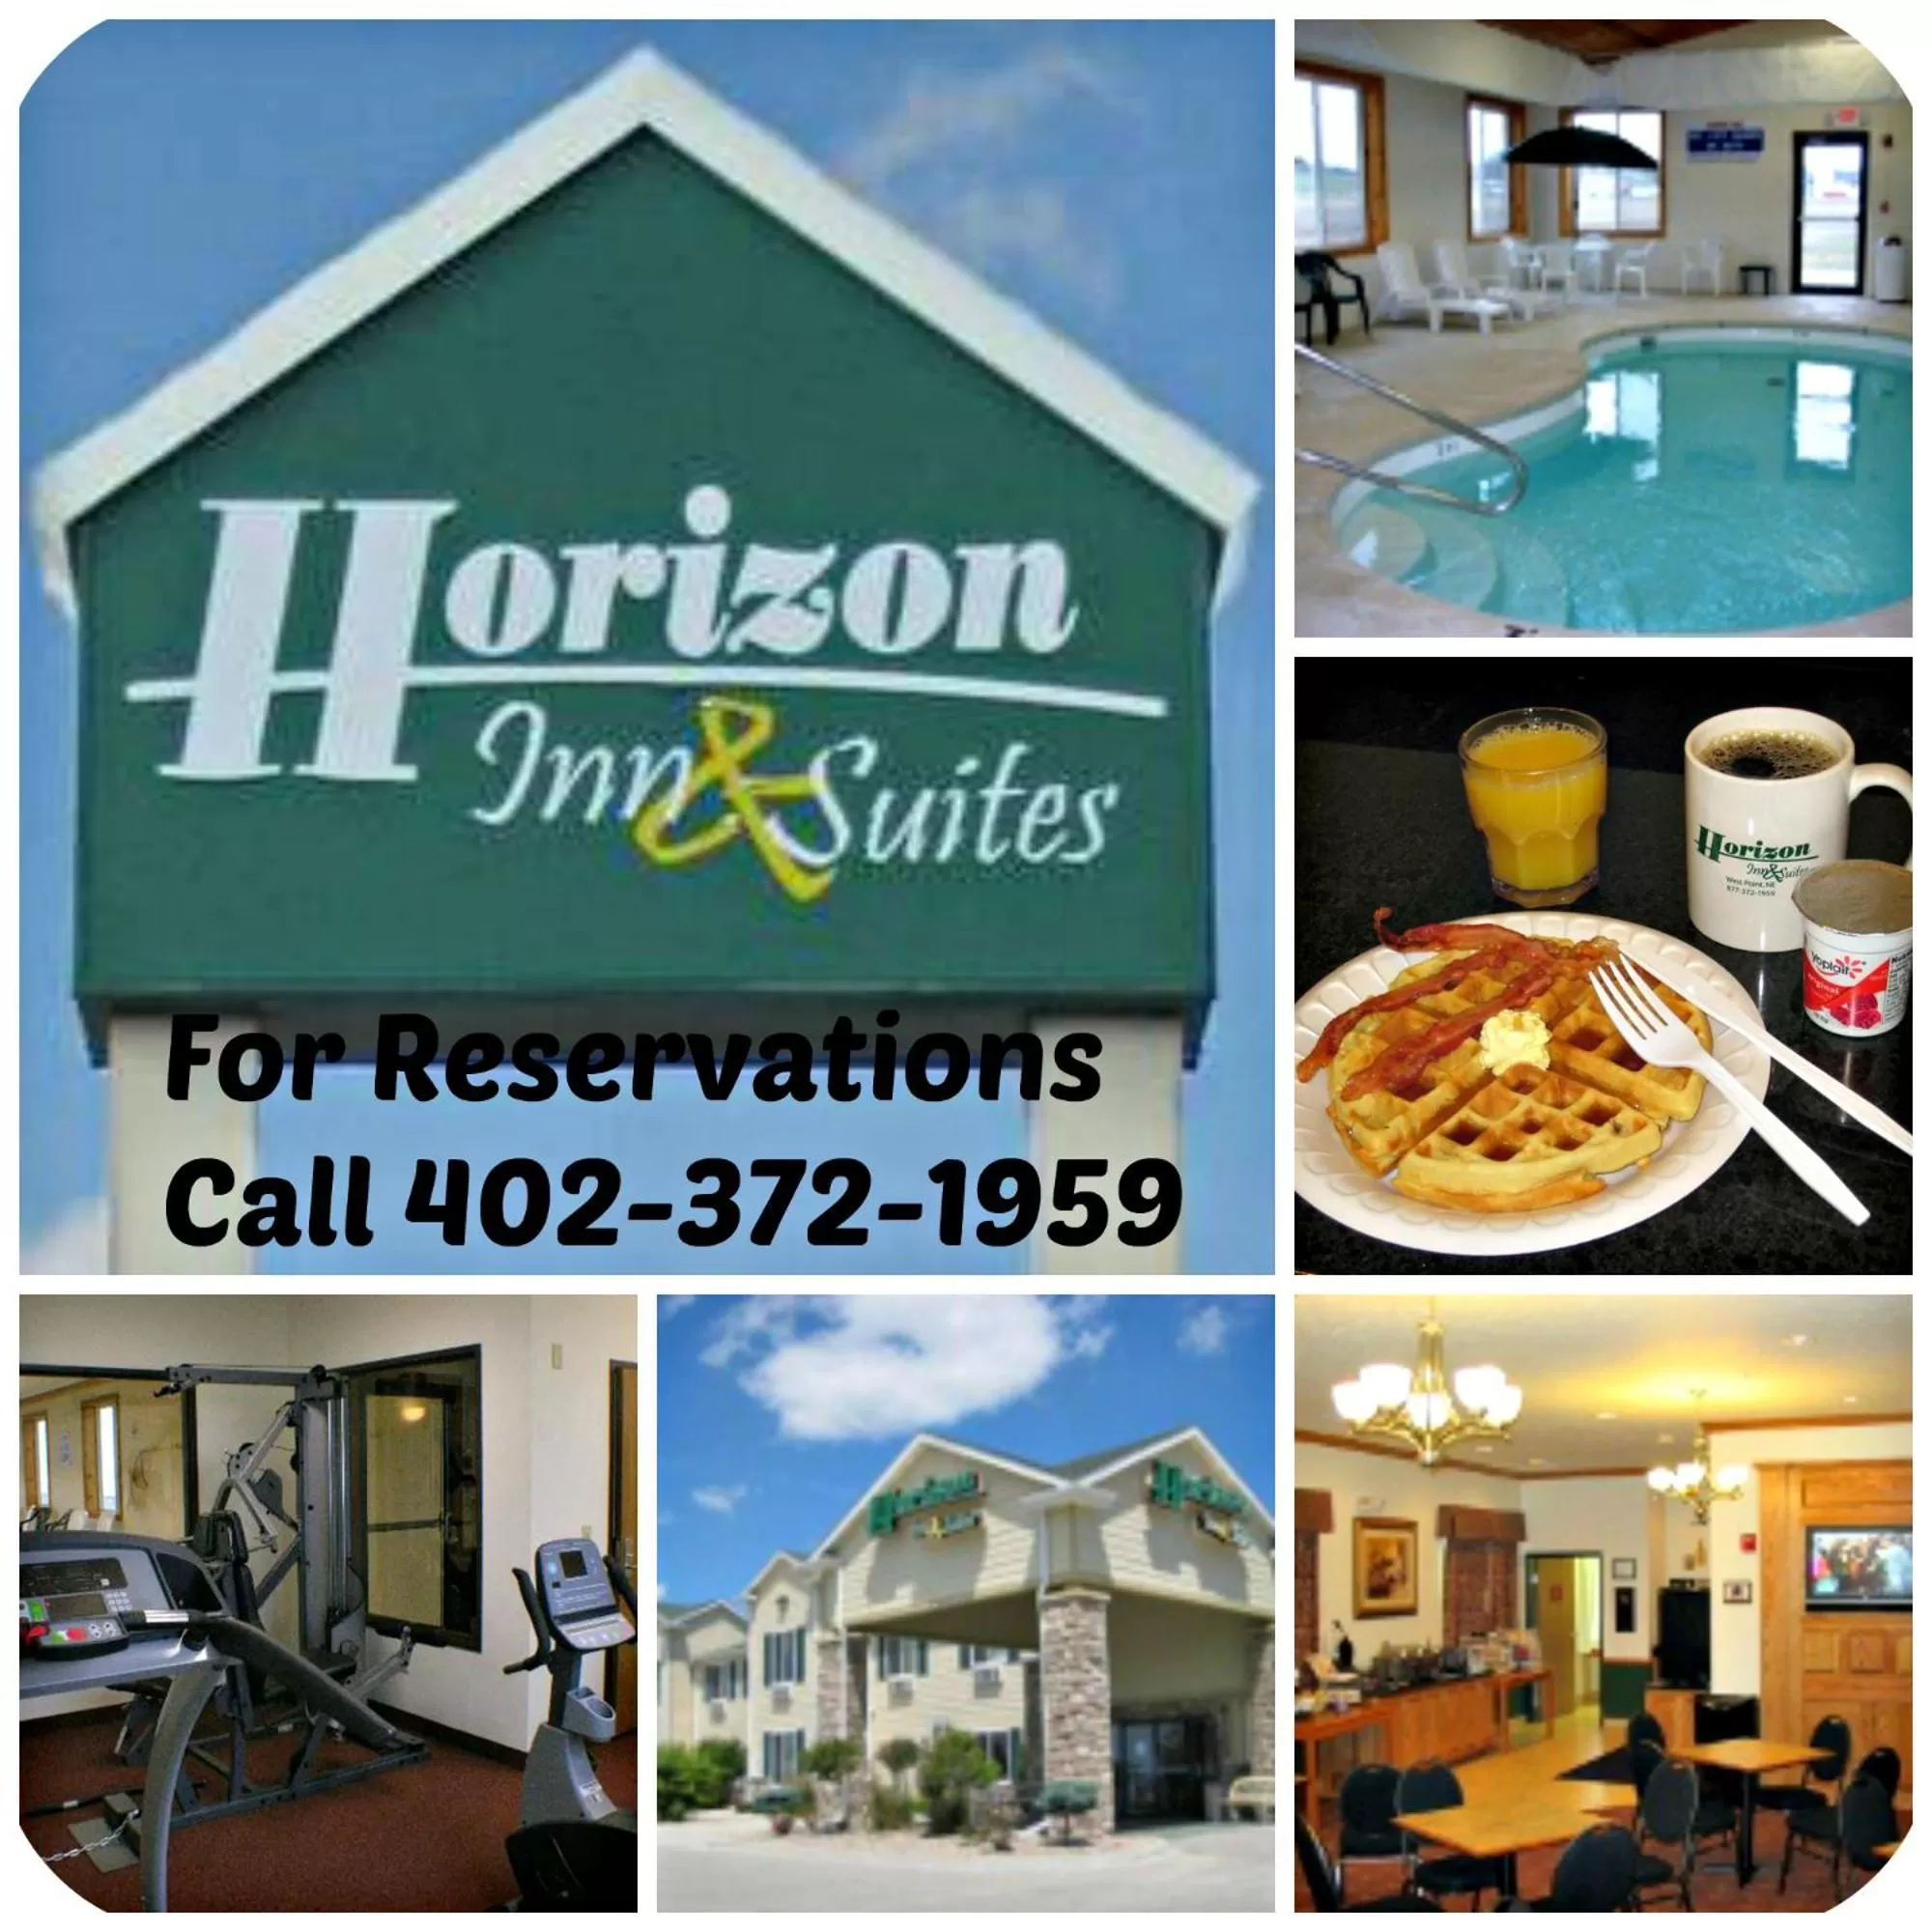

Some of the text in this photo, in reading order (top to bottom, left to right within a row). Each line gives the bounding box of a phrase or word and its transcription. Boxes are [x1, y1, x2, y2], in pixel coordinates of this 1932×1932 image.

[158, 484, 1080, 781] Horizon
[466, 695, 1120, 903] Inn & Suites
[1696, 824, 1812, 864] Horizon
[1746, 862, 1768, 875] Inn
[1762, 863, 1783, 883] &
